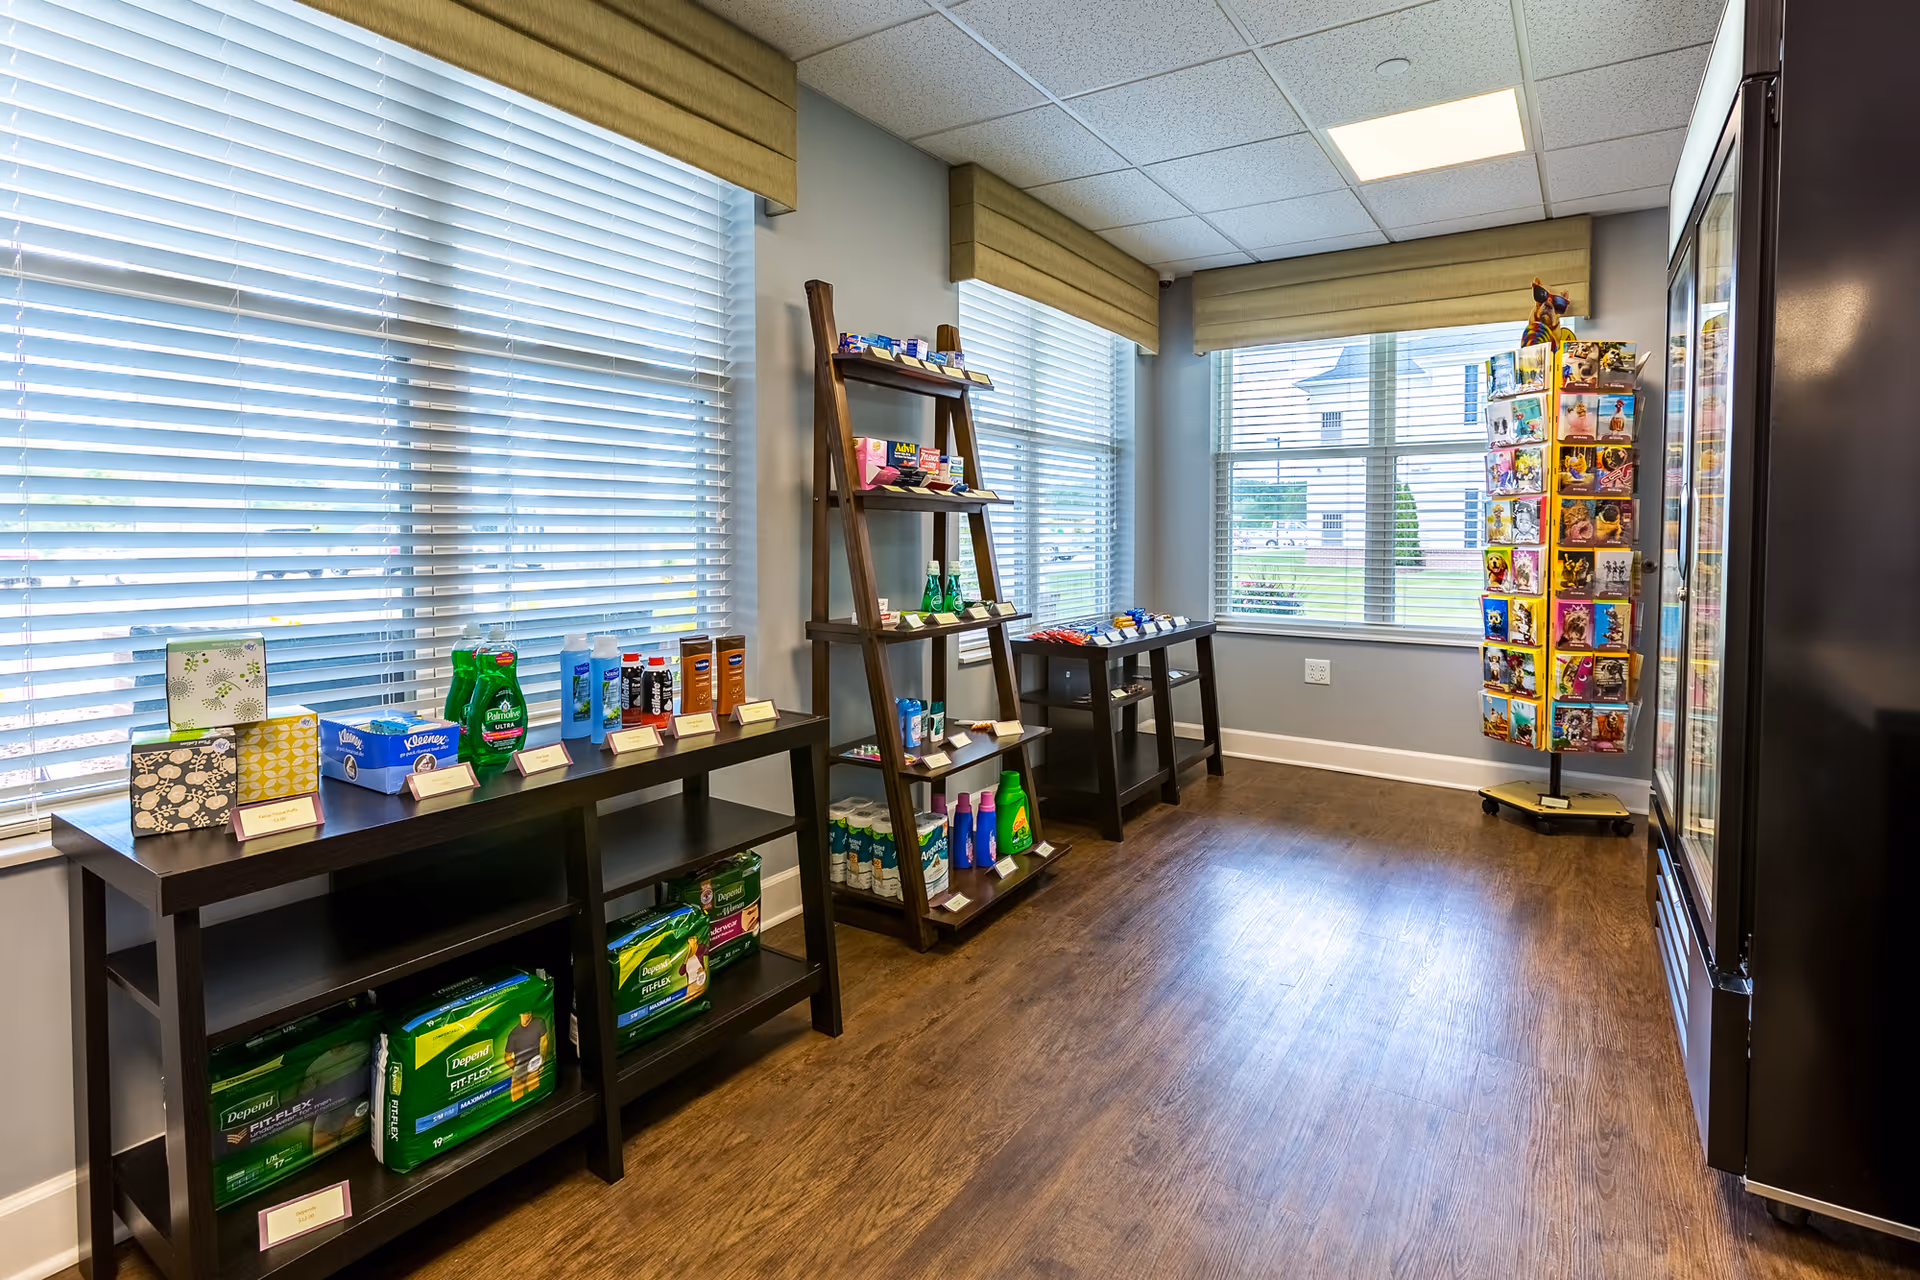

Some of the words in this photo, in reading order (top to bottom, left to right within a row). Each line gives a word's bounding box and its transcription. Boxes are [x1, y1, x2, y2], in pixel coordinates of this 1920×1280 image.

[895, 442, 915, 454] Advil
[622, 676, 630, 710] Gillette
[652, 681, 661, 715] Gillette
[486, 709, 521, 721] Palmolive
[495, 722, 515, 730] ULTRA
[338, 728, 363, 750] Kleenex
[404, 734, 447, 751] Kleenex
[921, 840, 939, 861] Angel
[718, 884, 743, 903] Depend
[710, 920, 738, 936] nderwear
[642, 959, 669, 977] Depend
[641, 976, 672, 995] FIT-FLEX
[425, 1019, 435, 1028] 19
[451, 1044, 491, 1070] Depend
[391, 1066, 399, 1094] Depend
[450, 1065, 494, 1092] FIT-FLEX
[227, 1095, 274, 1123] Depend
[460, 1089, 493, 1109] MAXIMUM
[250, 1098, 314, 1133] FIT-FLEX
[250, 1113, 297, 1138] underwear
[299, 1107, 312, 1116] for
[314, 1098, 332, 1108] men
[390, 1099, 399, 1141] FIT-FLEX
[433, 1137, 443, 1148] 19
[273, 1158, 285, 1169] 17
